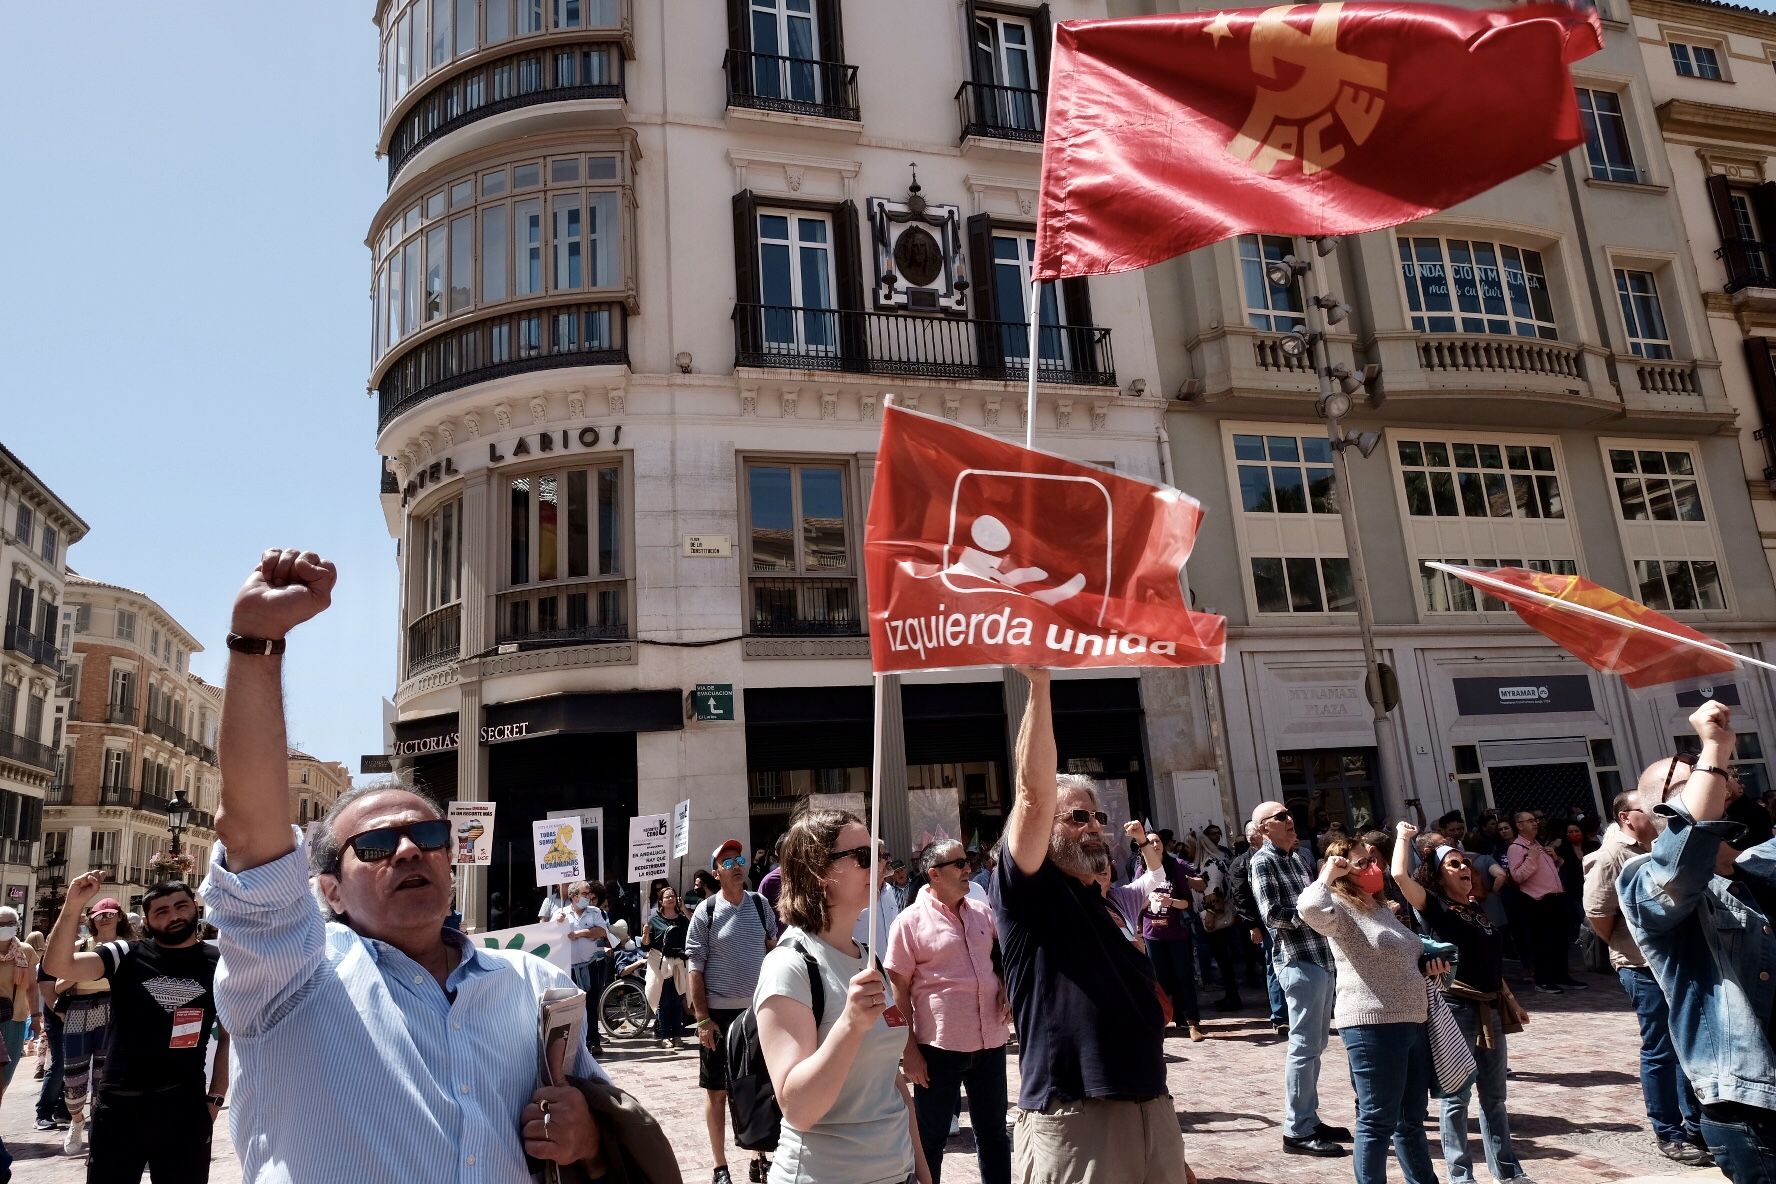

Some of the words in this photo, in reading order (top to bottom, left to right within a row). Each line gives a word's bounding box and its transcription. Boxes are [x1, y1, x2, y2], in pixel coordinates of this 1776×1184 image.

[1250, 85, 1386, 176] PCE
[489, 425, 622, 462] LARIOS
[884, 604, 1032, 660] izquierda
[1045, 623, 1177, 657] unida
[1500, 689, 1537, 698] MYRAMAR
[392, 732, 460, 757] VICTORIA'S
[480, 721, 529, 742] SECRET
